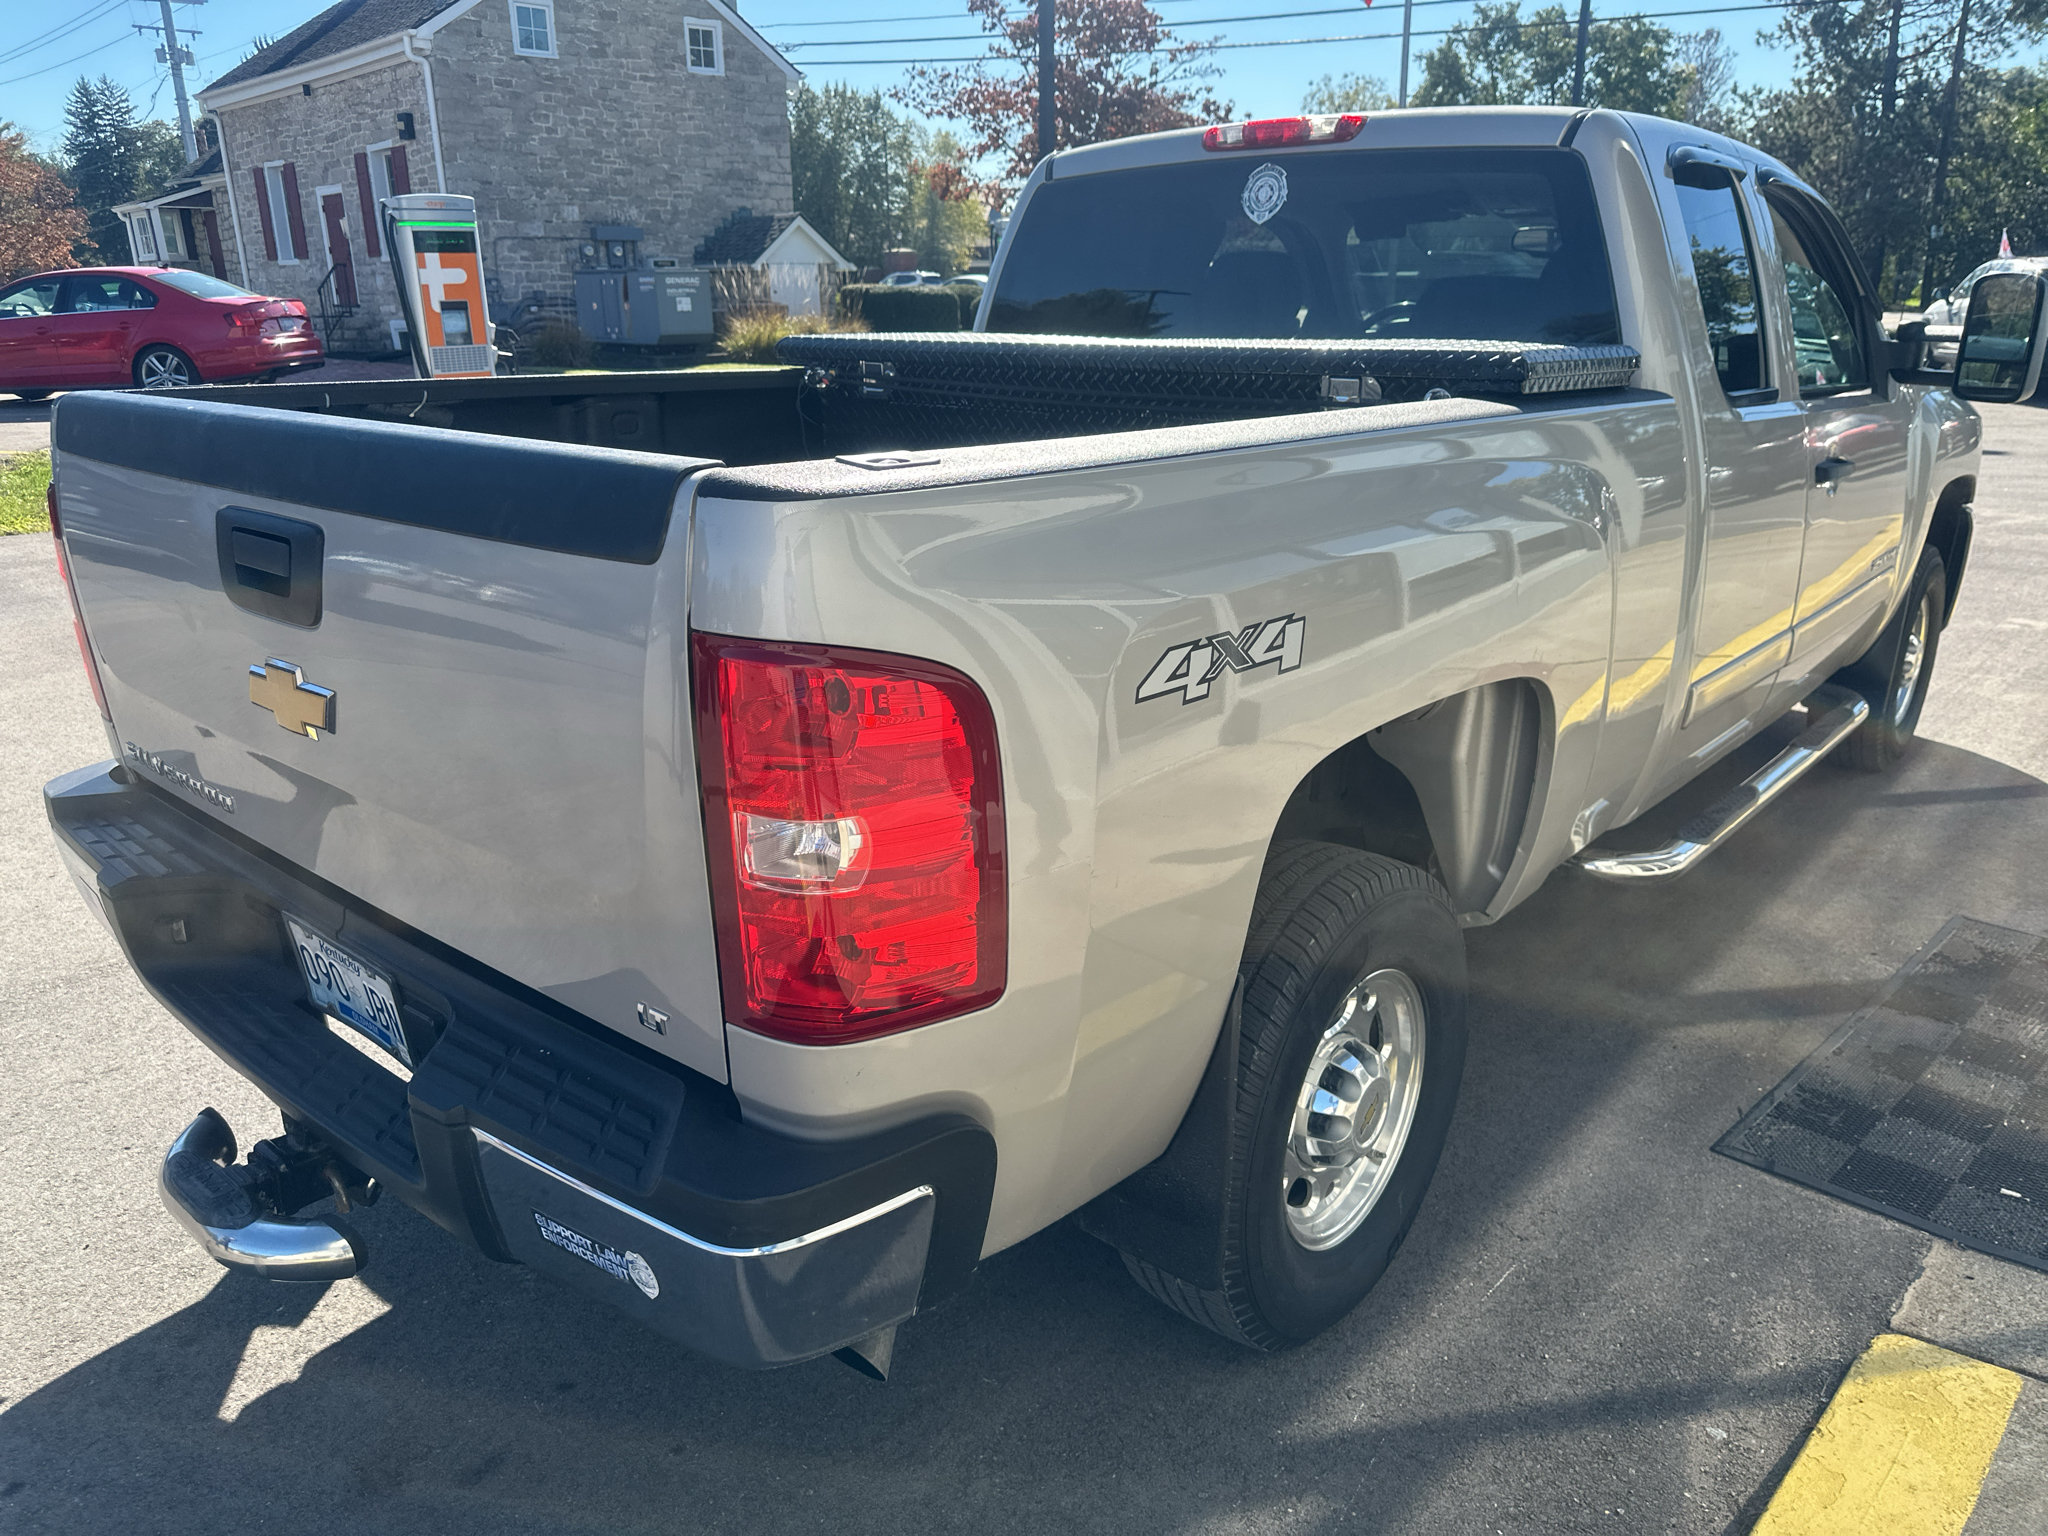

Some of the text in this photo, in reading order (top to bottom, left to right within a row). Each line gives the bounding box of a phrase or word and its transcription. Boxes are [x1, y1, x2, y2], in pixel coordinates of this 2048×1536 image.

[664, 276, 700, 284] GENERAC
[318, 939, 362, 977] Kentucky
[300, 943, 409, 1048] 090 JBN
[637, 1000, 671, 1036] LT
[534, 1213, 628, 1269] SUPPORT LAW
[540, 1226, 629, 1281] ENFORCEMENT
